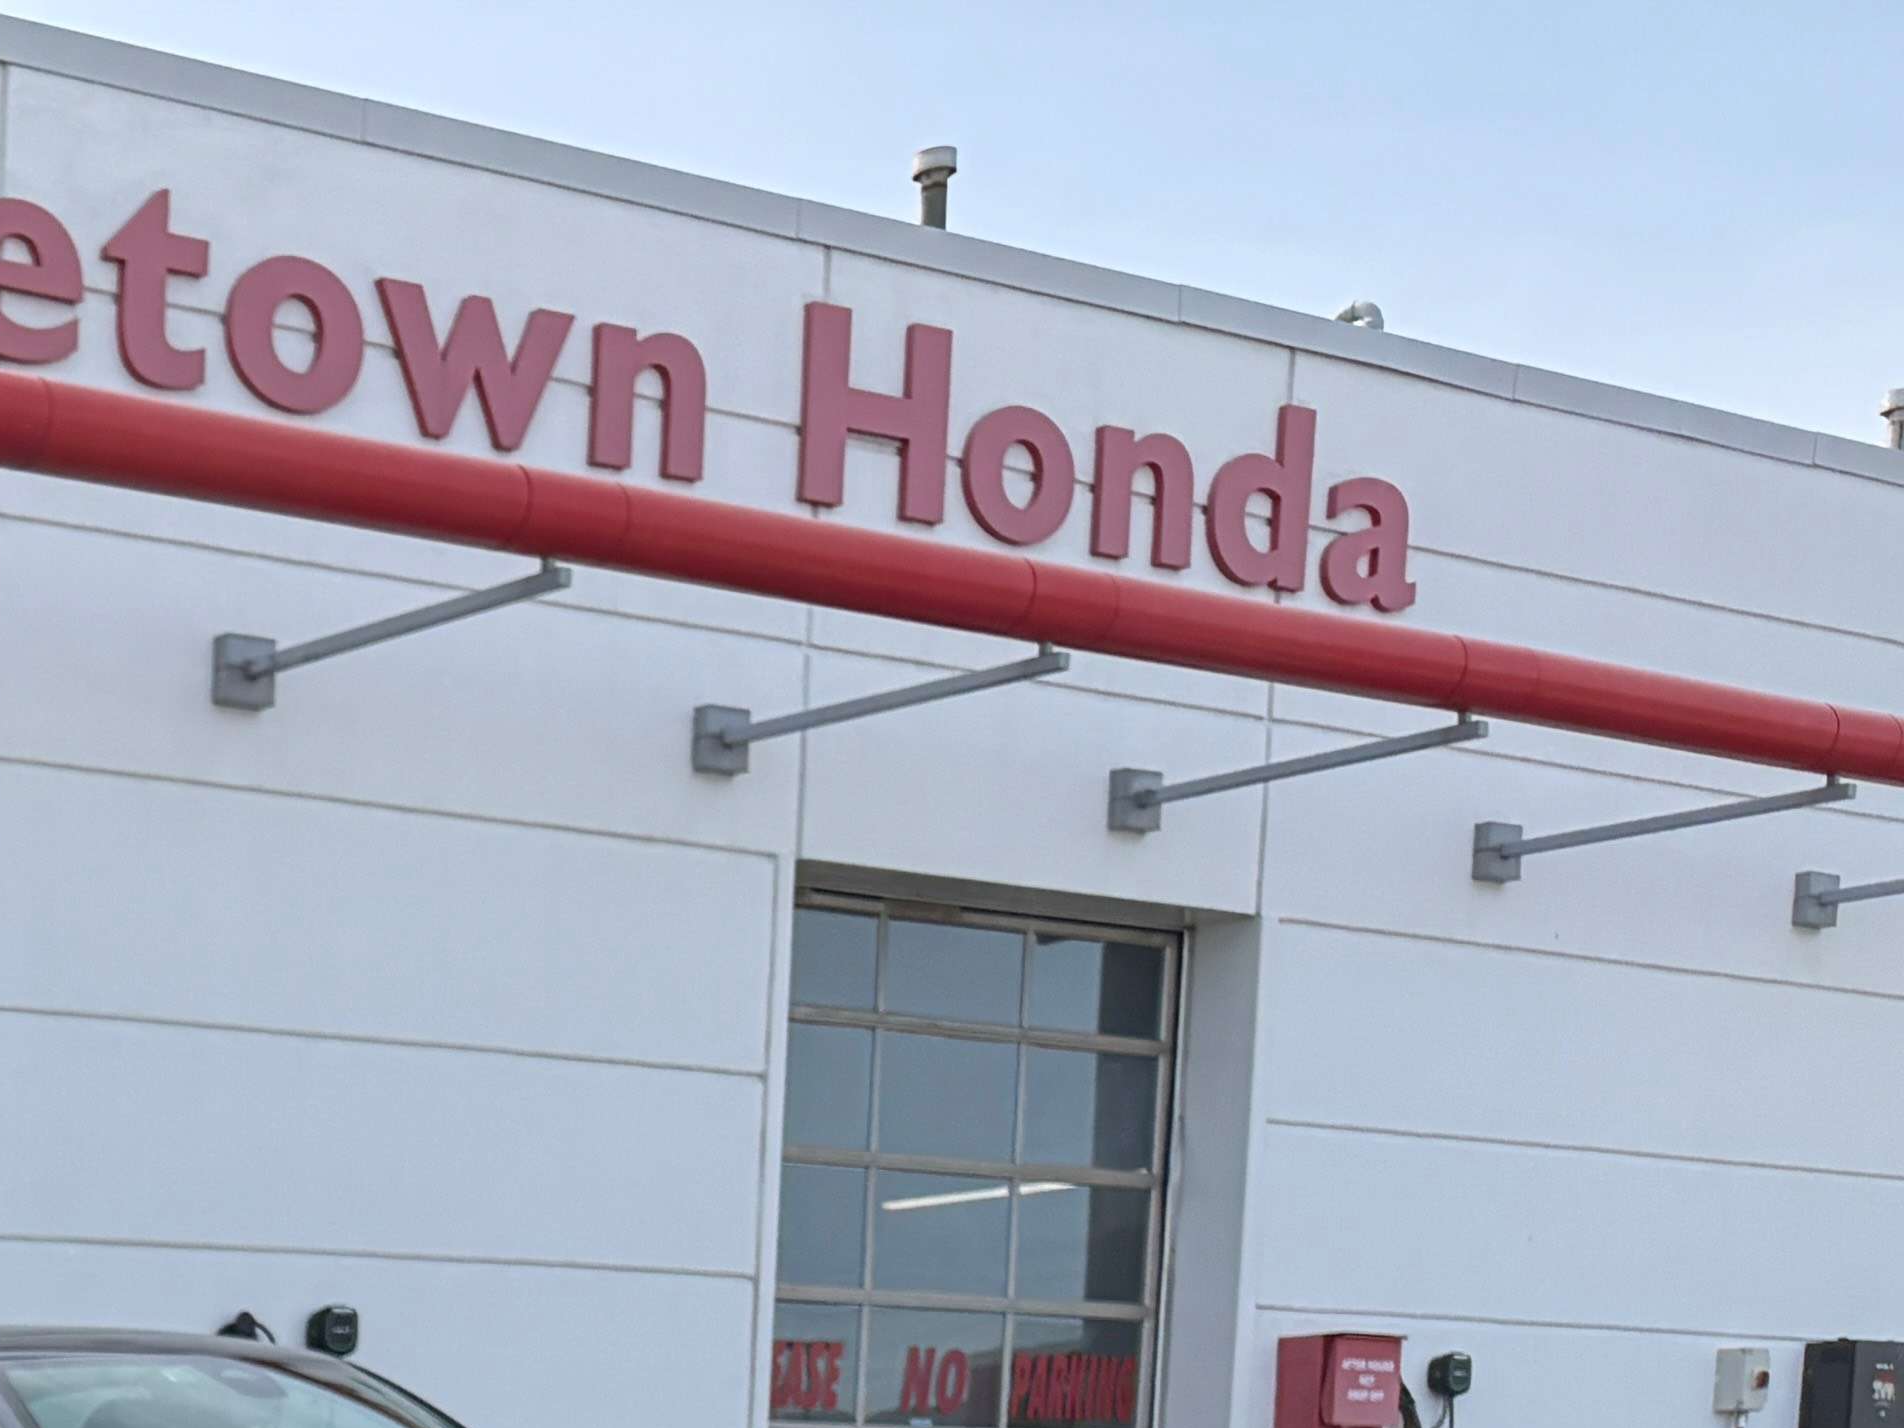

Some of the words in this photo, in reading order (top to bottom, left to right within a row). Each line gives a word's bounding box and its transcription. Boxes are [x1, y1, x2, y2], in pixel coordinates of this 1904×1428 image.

[795, 301, 1416, 612] Honda
[901, 1346, 970, 1416] NO
[1011, 1352, 1137, 1421] PARKING
